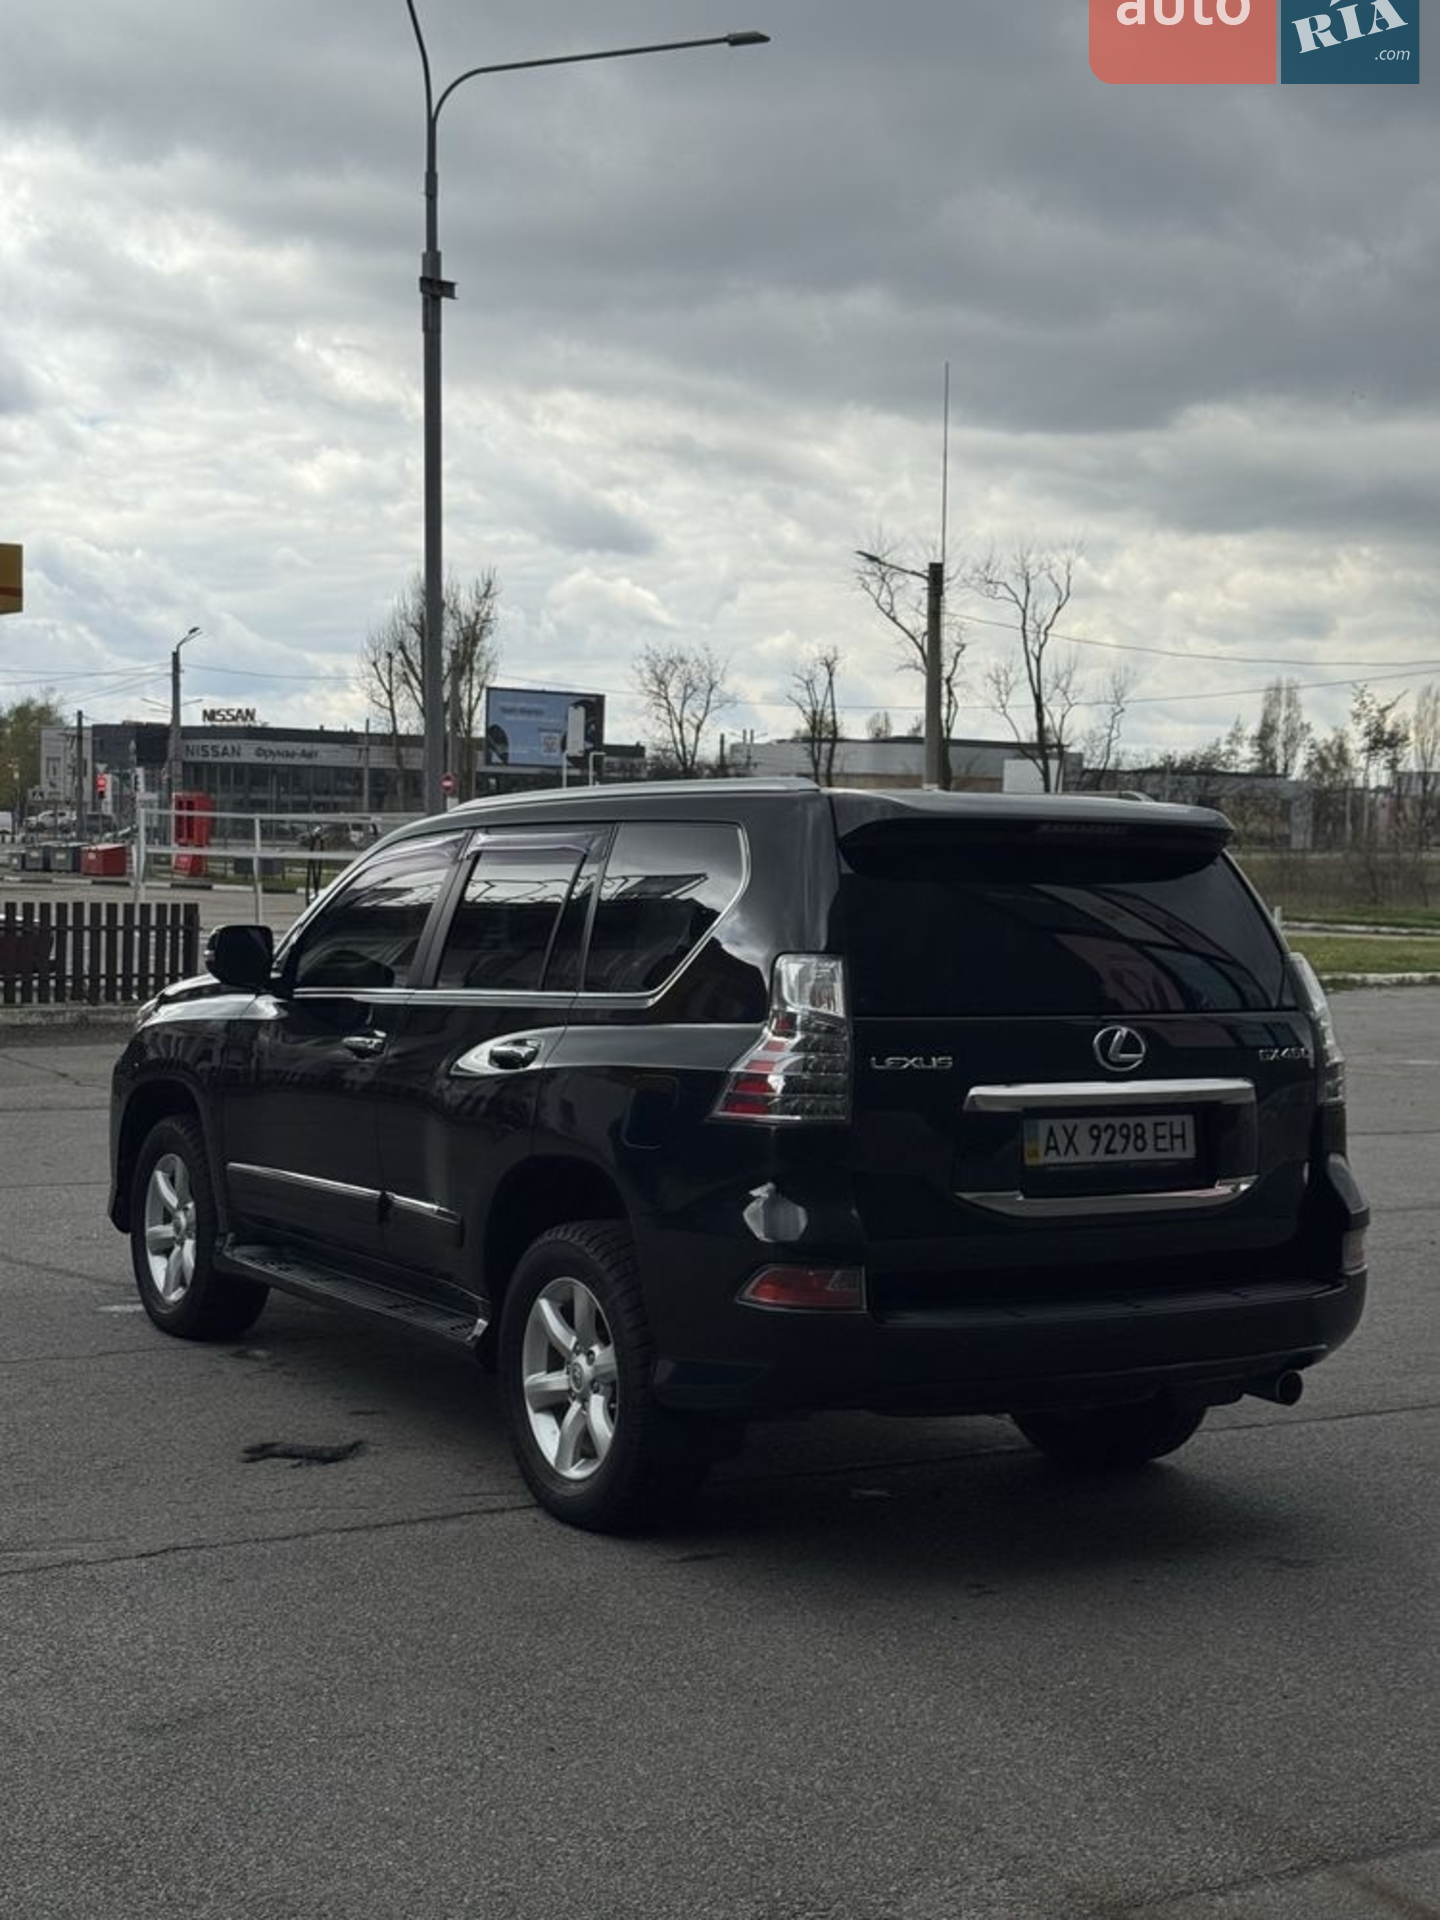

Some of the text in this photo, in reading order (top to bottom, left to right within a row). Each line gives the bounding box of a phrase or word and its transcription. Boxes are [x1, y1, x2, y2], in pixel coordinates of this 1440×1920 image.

[202, 708, 257, 723] NISSAN
[185, 743, 242, 758] NISSAN
[870, 1055, 954, 1071] LEXUS
[1044, 1121, 1187, 1157] AX 9298 EH
